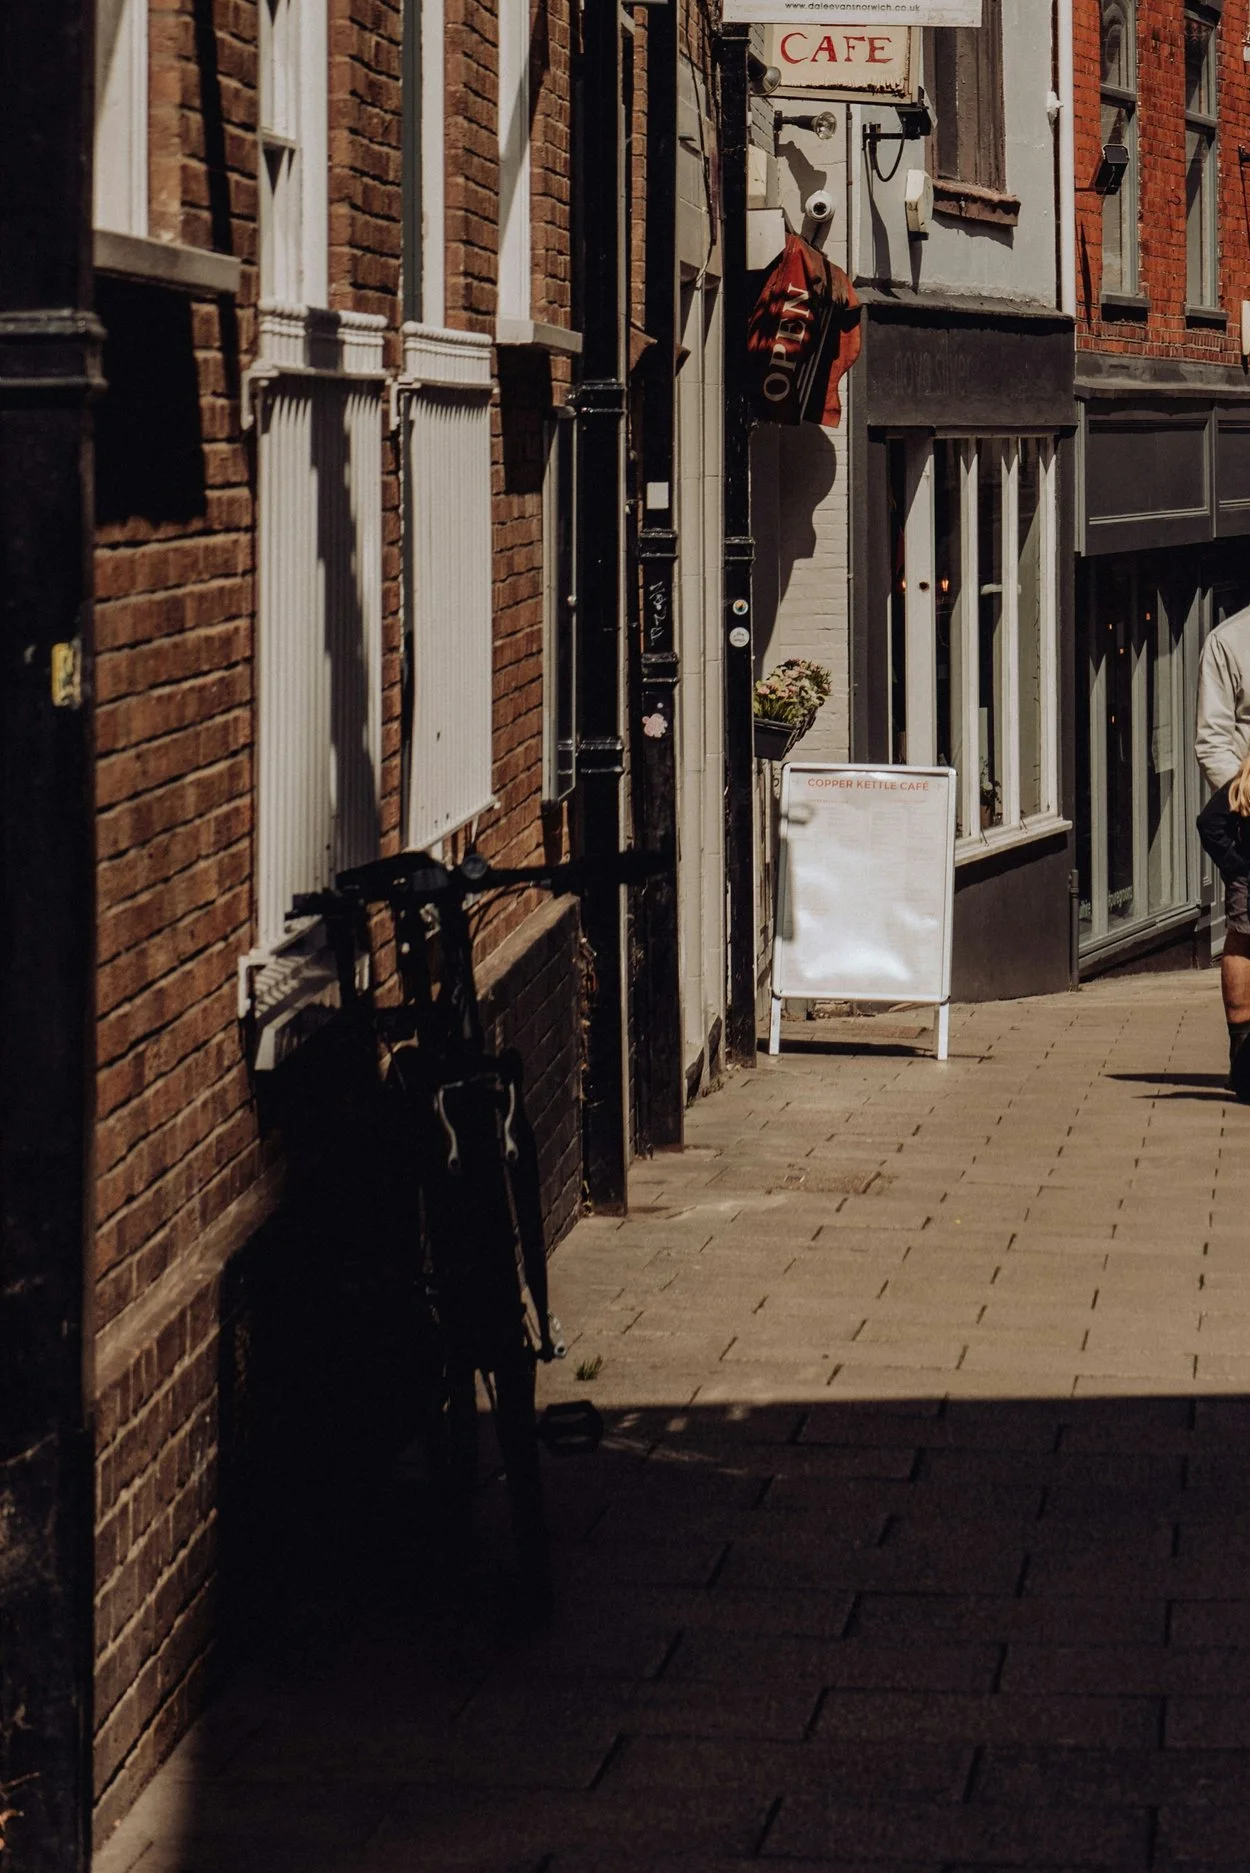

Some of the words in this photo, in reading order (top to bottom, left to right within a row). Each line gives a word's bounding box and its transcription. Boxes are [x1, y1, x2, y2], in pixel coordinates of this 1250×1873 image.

[780, 32, 894, 64] CAFE
[763, 283, 812, 403] OPEN
[808, 778, 852, 789] COPPER
[856, 779, 897, 790] KETTLE
[900, 780, 929, 792] CAFÉ
